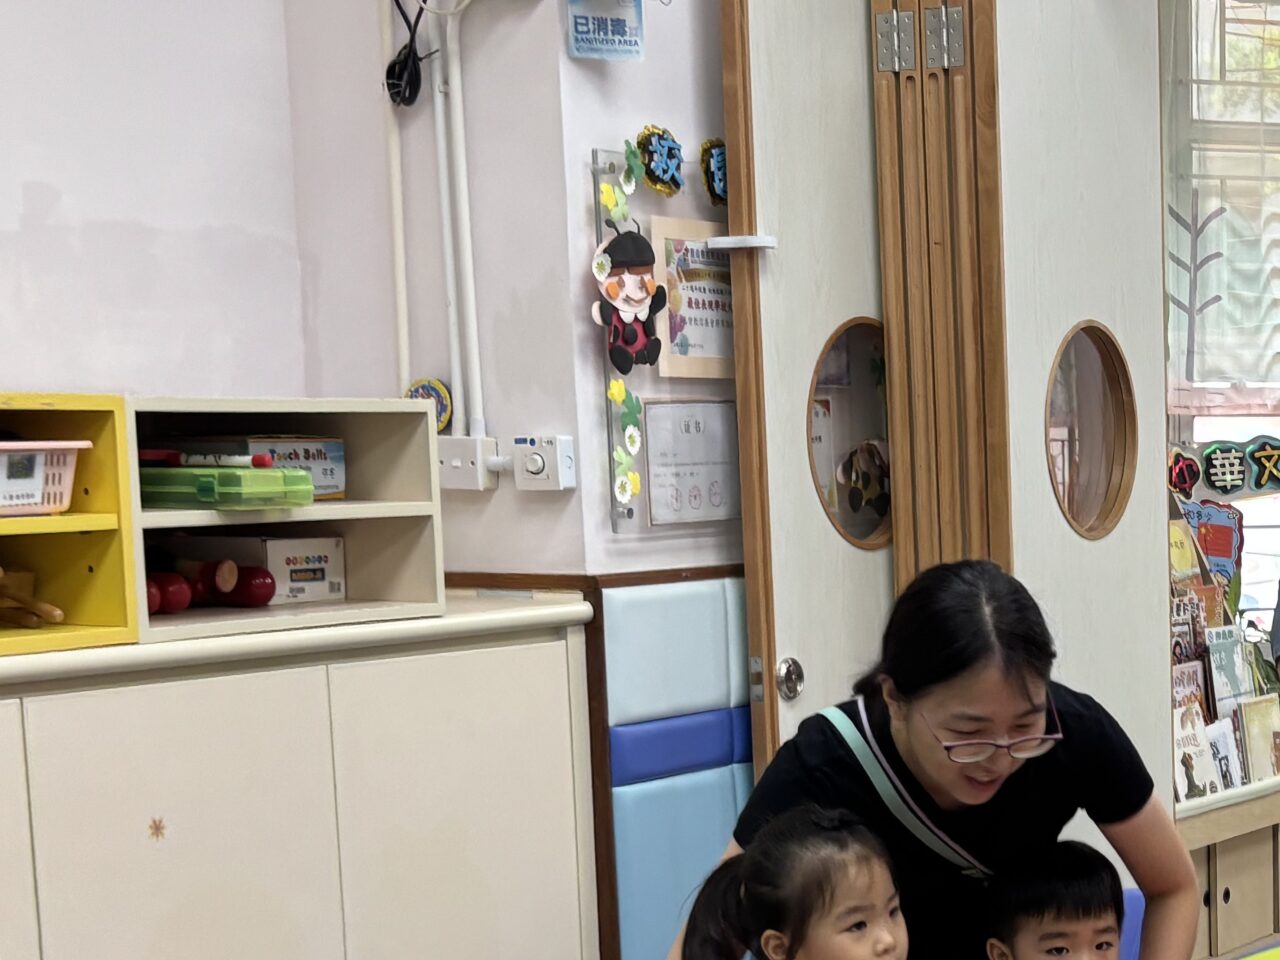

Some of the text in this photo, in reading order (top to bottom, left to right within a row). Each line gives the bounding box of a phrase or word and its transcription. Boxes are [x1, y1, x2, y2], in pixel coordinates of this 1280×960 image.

[573, 15, 628, 37] 已消毒
[618, 39, 640, 47] AREA
